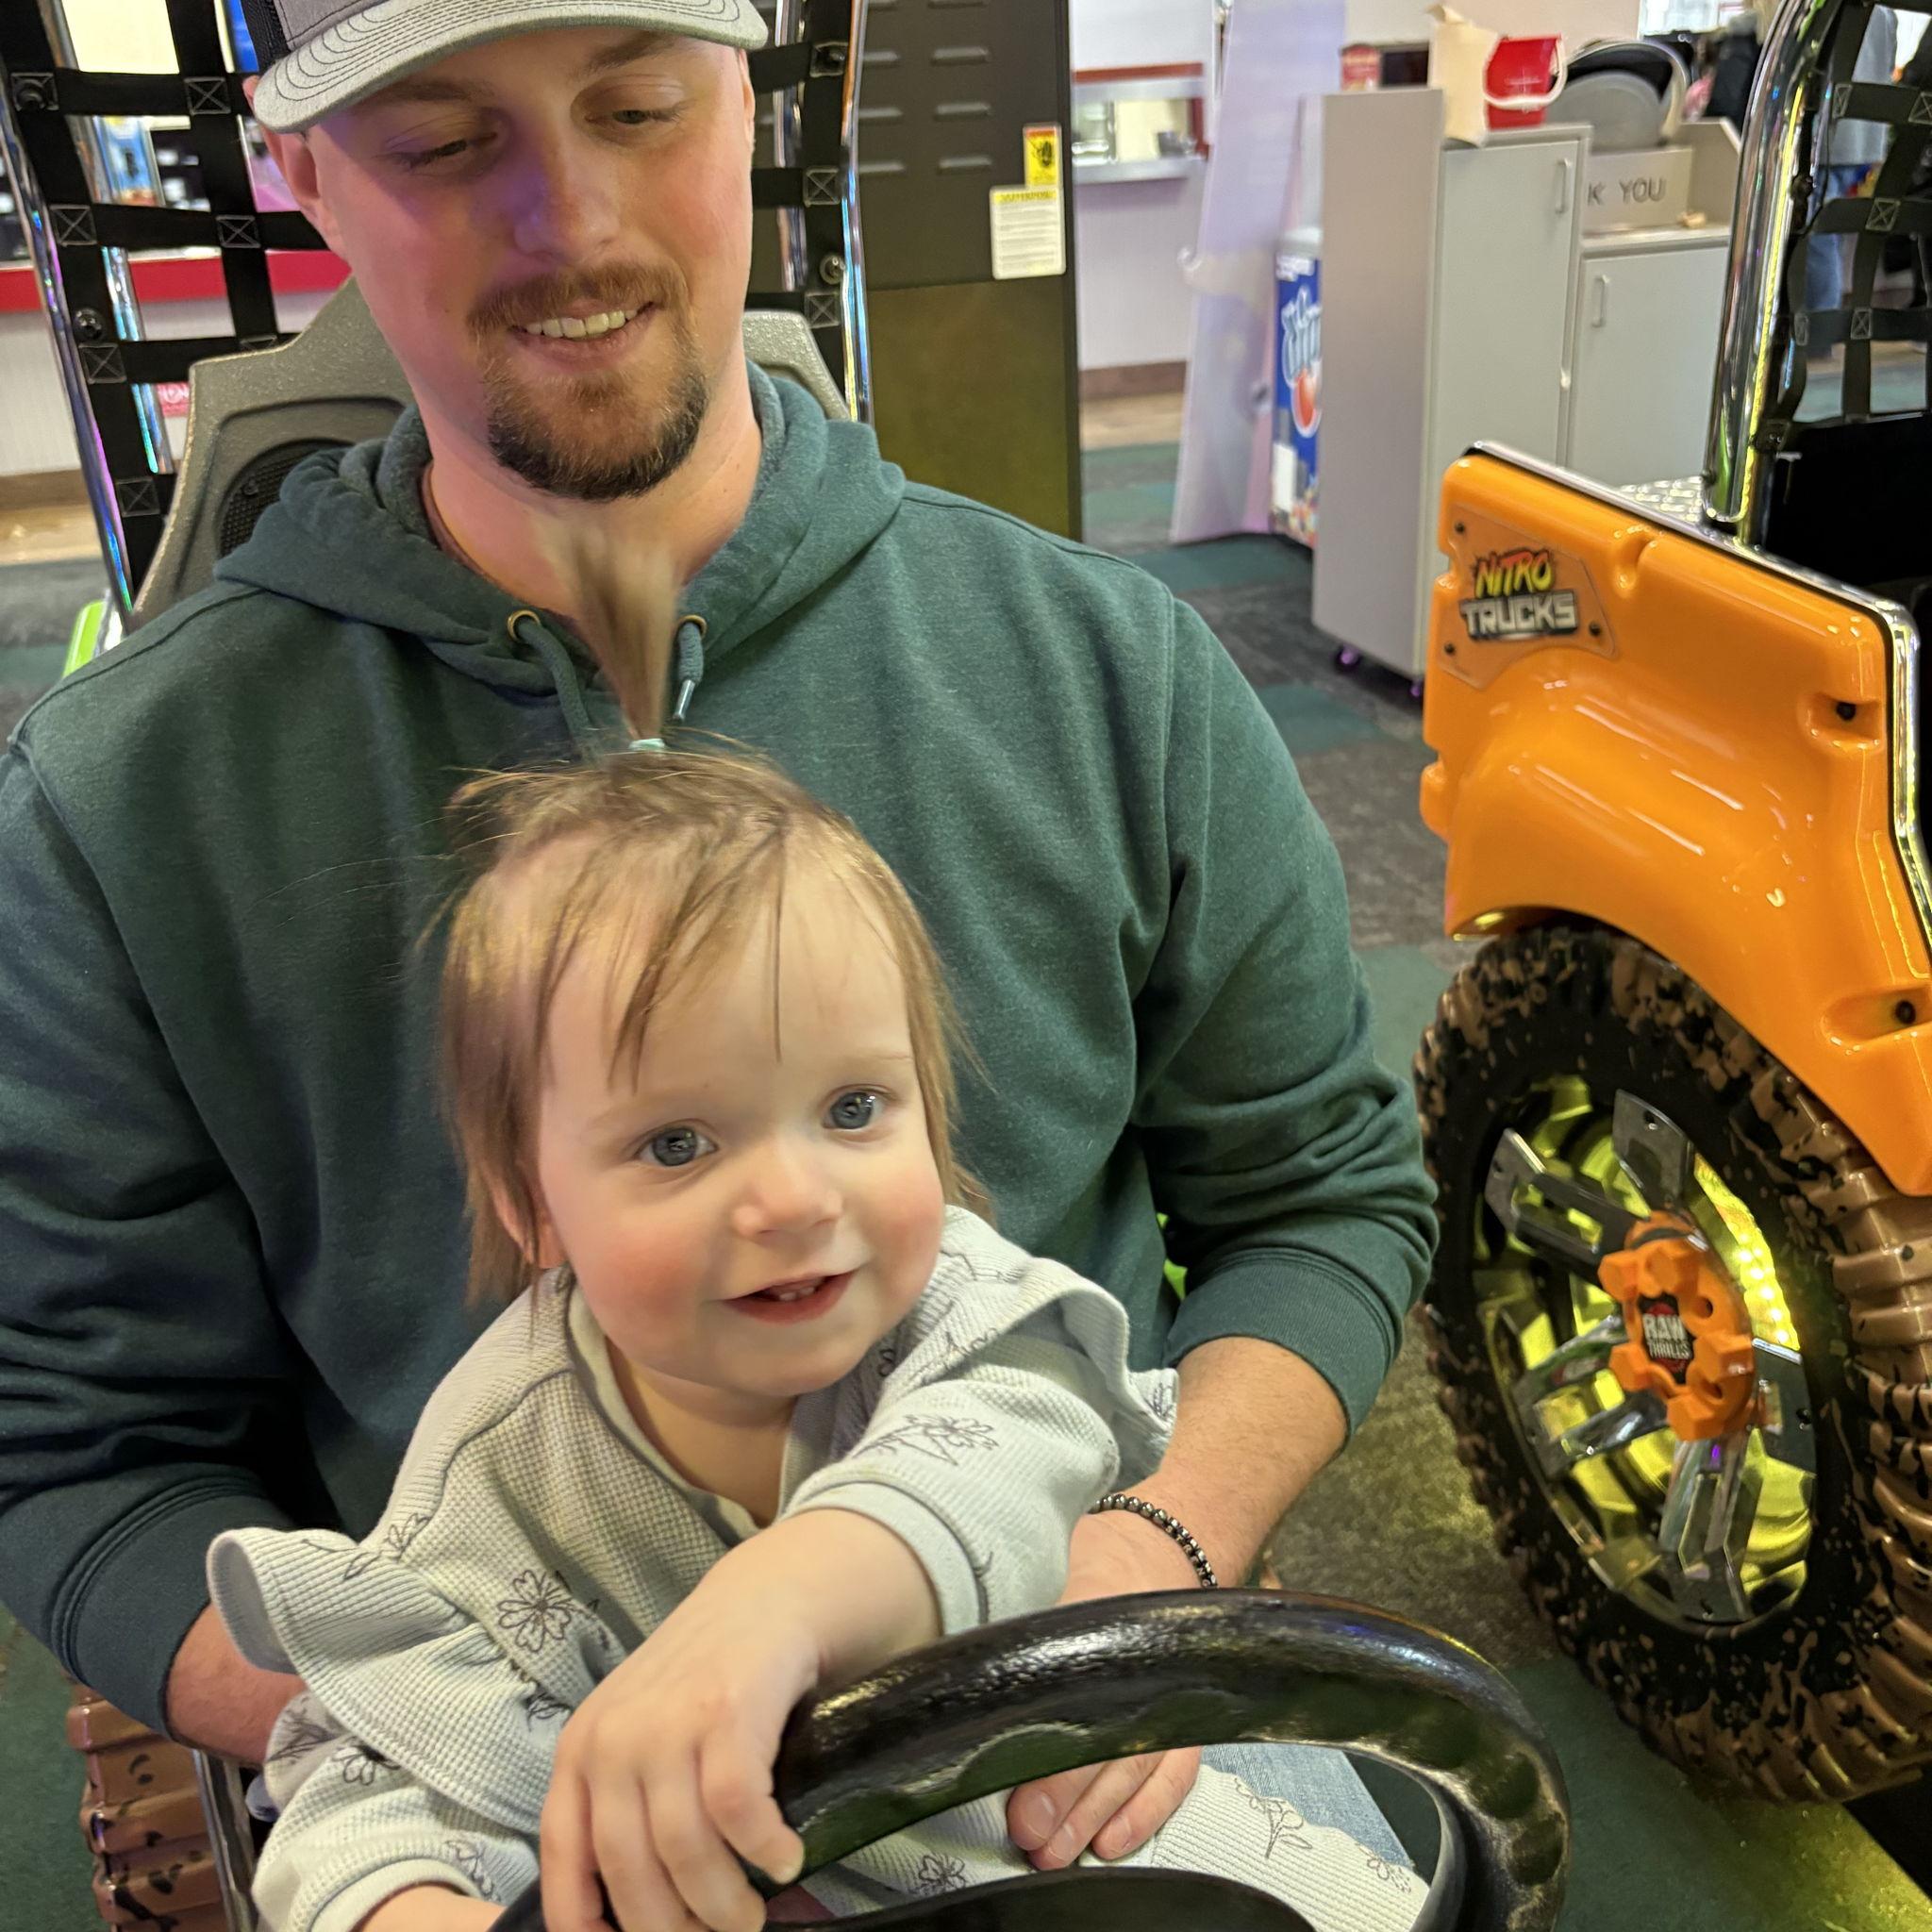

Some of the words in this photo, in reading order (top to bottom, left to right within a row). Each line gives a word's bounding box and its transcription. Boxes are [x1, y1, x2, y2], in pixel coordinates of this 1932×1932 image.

[1619, 177, 1667, 204] YOU
[1474, 550, 1552, 598] NITRO
[1460, 592, 1576, 635] TRUCKS
[1642, 1312, 1687, 1341] RAW
